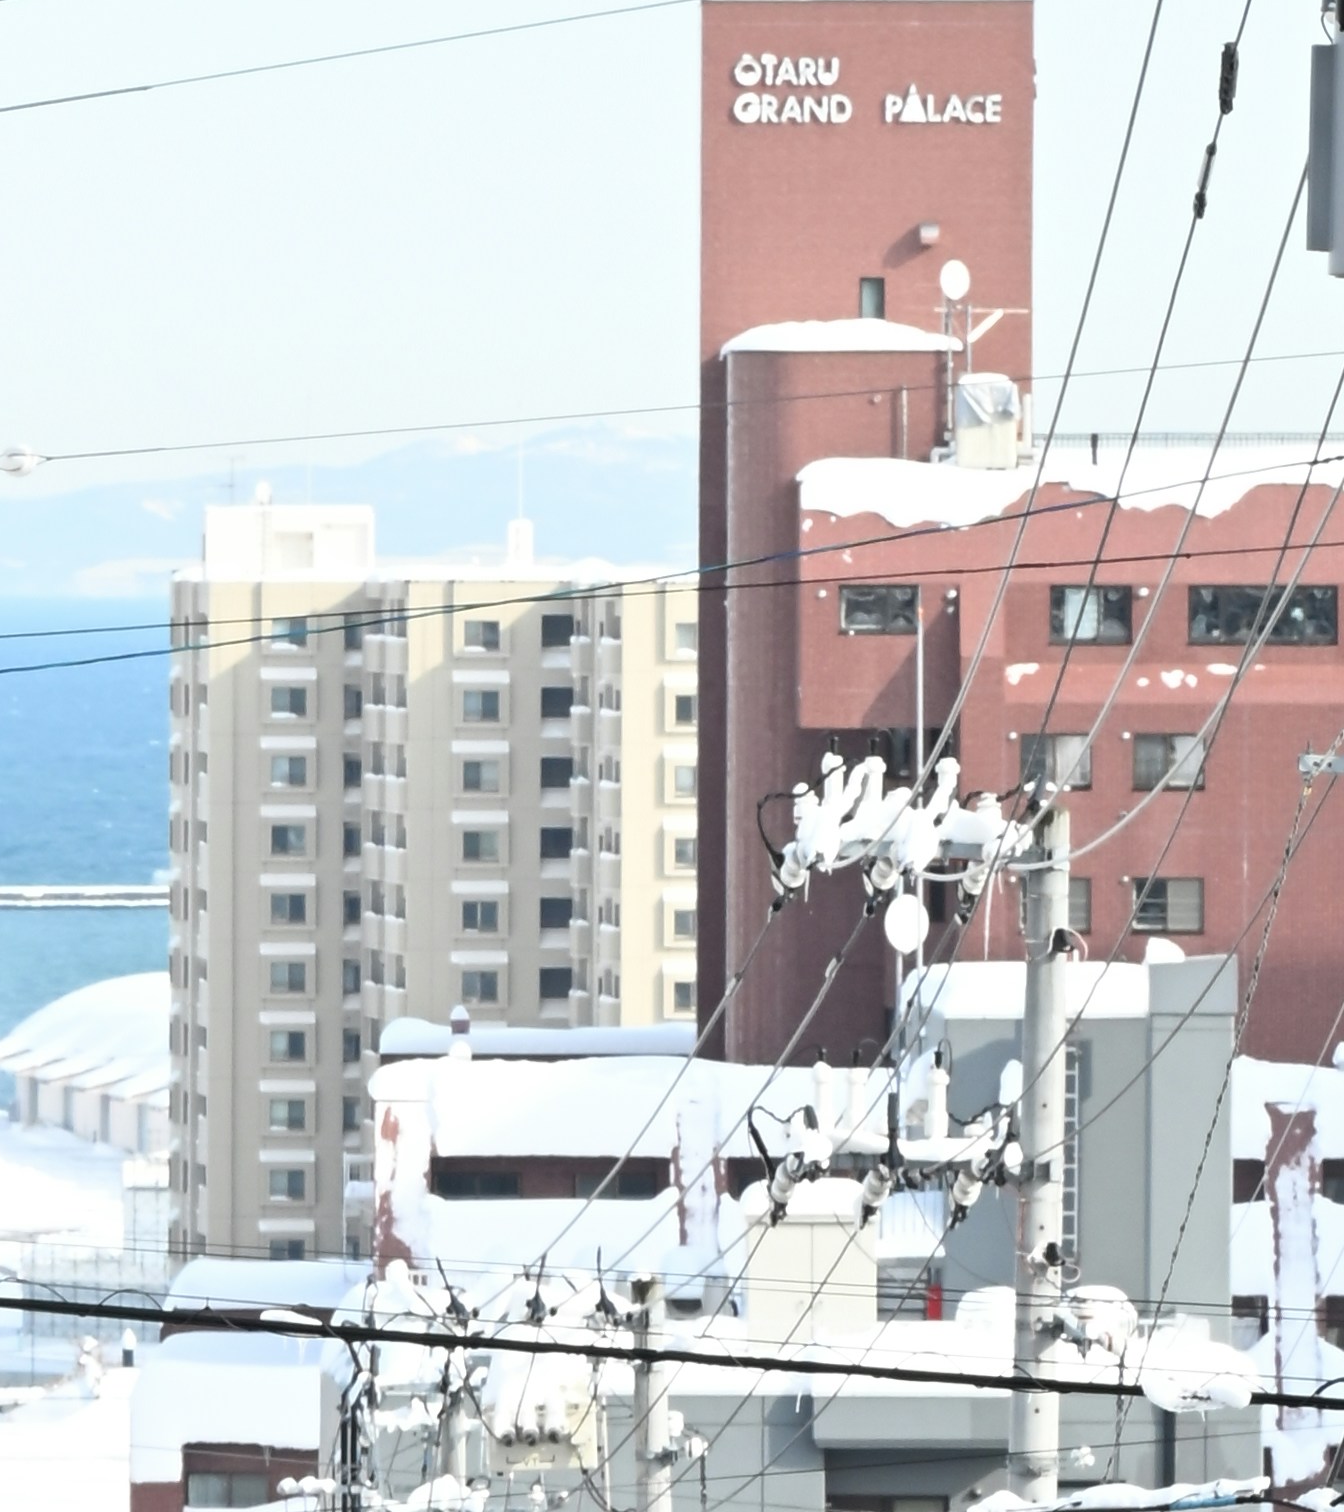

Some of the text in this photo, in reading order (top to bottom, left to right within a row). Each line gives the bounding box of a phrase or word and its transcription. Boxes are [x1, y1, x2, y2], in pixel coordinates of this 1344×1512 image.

[733, 53, 840, 87] OTARU
[732, 84, 1003, 124] GRAND PALACE
